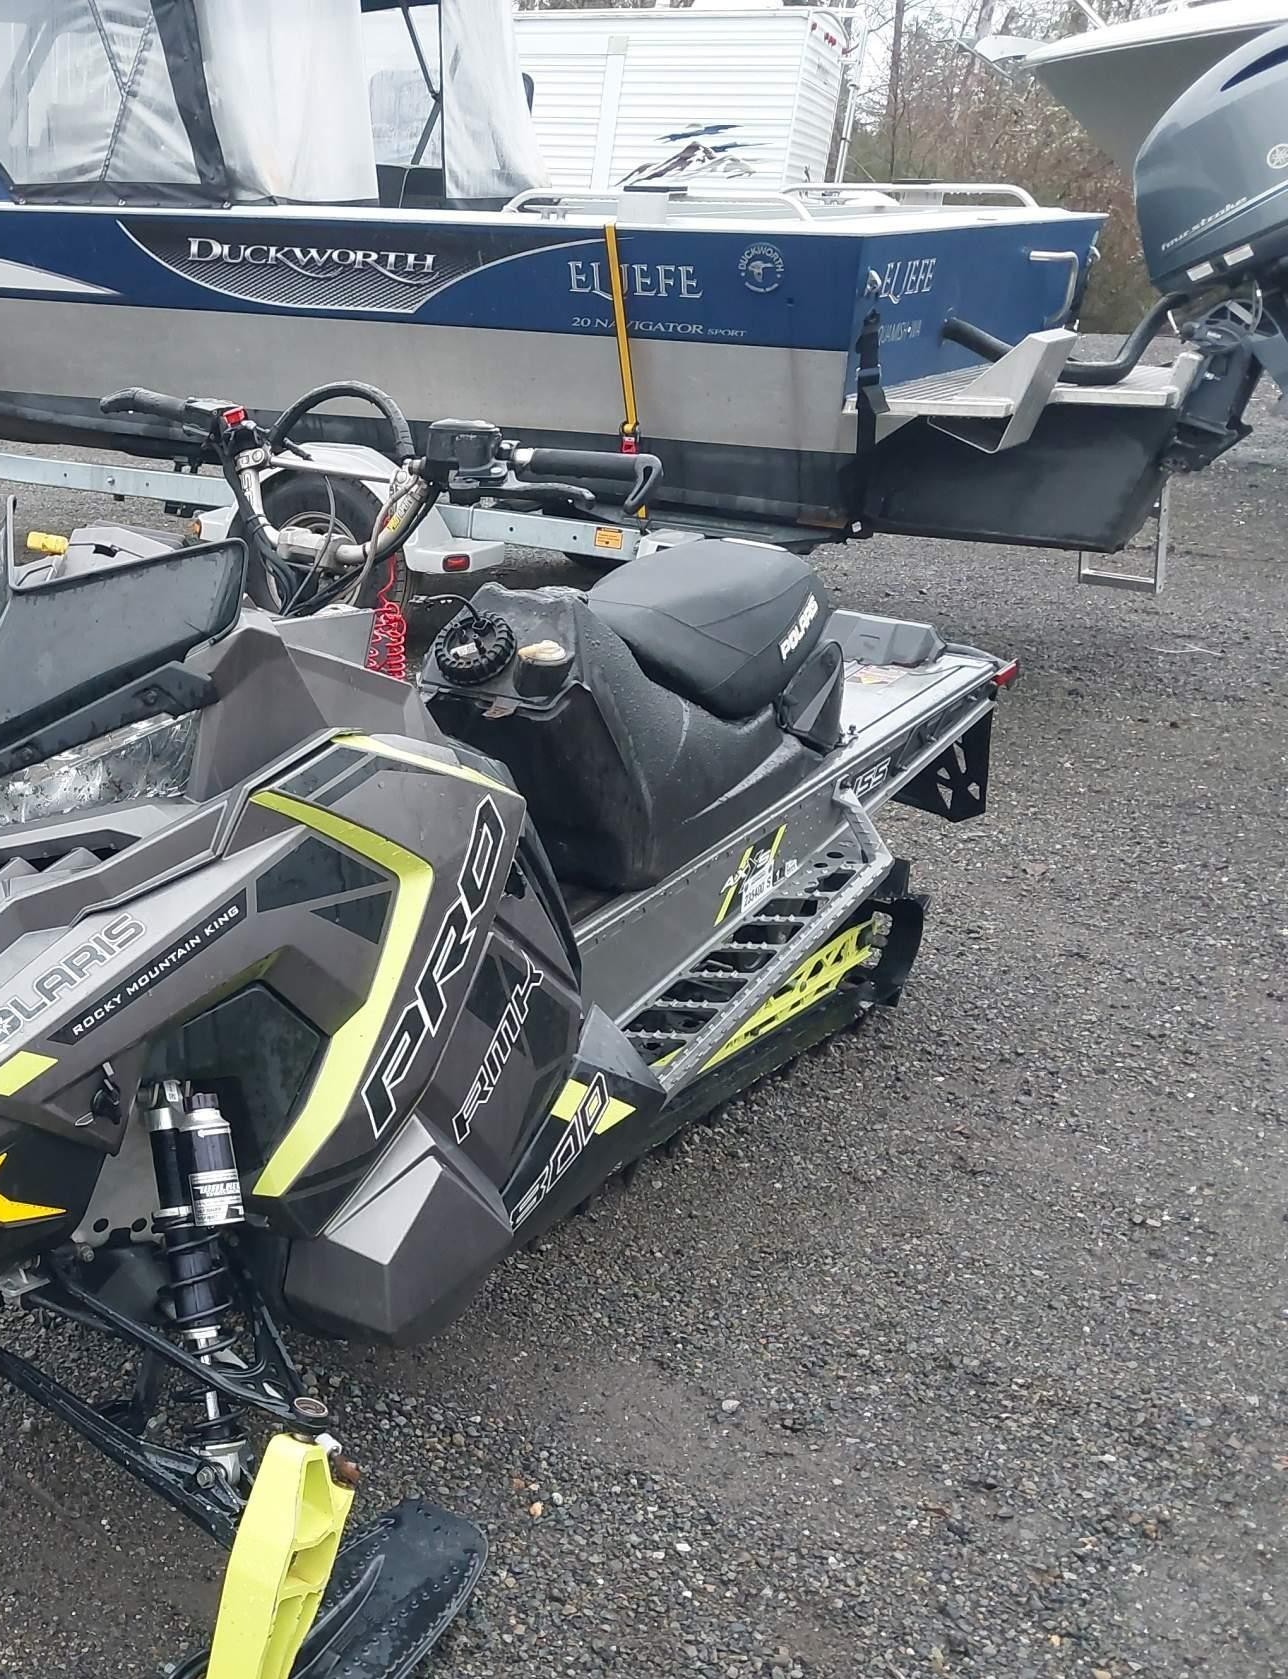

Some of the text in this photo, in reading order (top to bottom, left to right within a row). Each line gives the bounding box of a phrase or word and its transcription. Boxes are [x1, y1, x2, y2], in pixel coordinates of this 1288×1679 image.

[186, 237, 440, 287] DUCKWORTH
[738, 246, 785, 272] DUCKWORTH
[571, 316, 591, 328] 20
[707, 327, 748, 338] SPORT
[779, 591, 819, 661] POLARIS
[852, 756, 892, 799] 155
[72, 904, 241, 1036] ROCKY MOUNTAIN KING
[361, 794, 506, 1140] PRO
[452, 949, 544, 1144] RMK
[509, 1072, 611, 1233] 800
